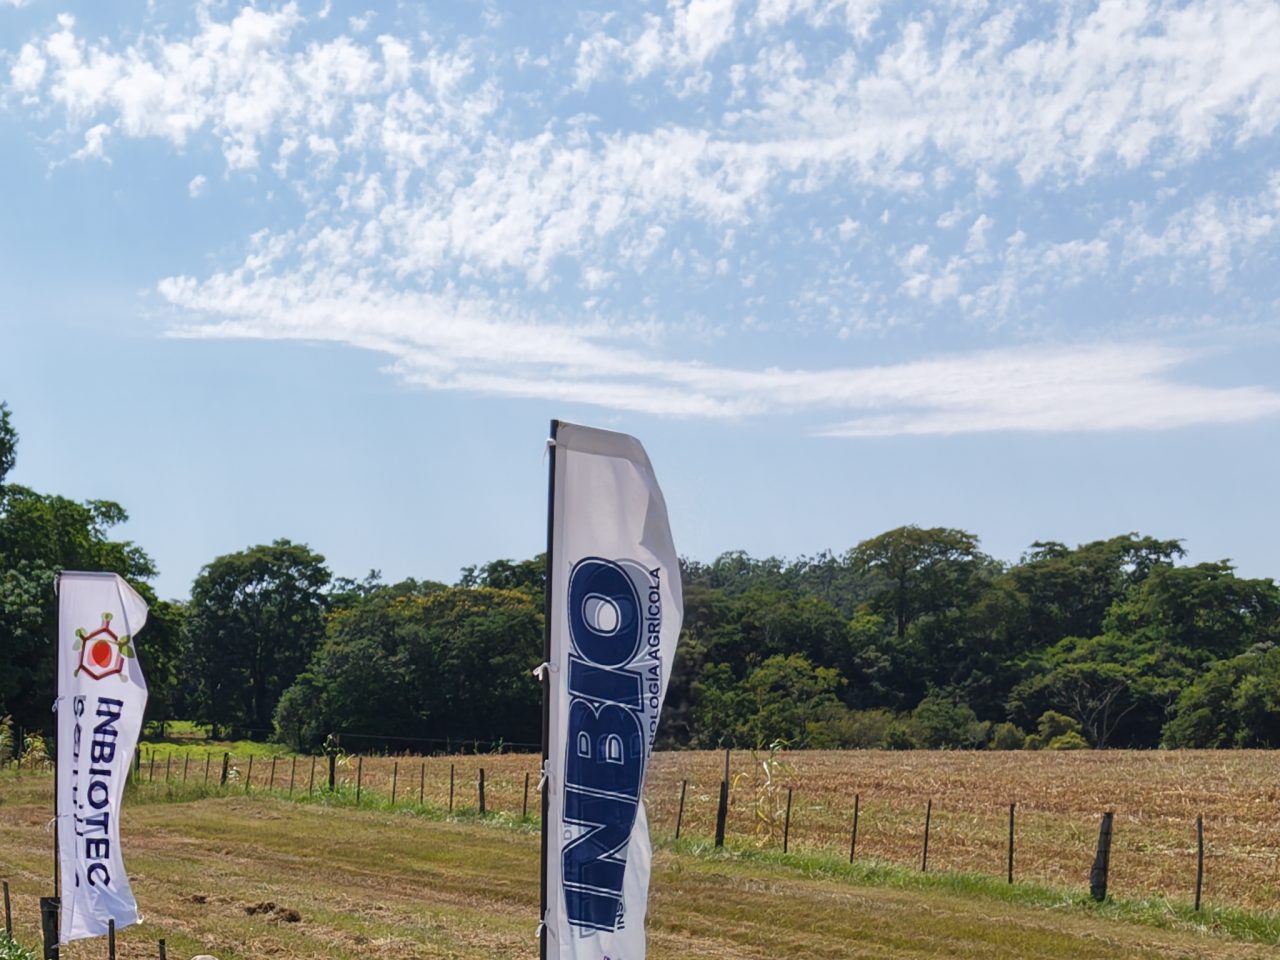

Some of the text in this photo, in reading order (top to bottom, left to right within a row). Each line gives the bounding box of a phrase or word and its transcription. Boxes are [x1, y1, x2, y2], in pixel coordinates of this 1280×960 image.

[645, 567, 661, 661] AGRÍCOLA
[85, 695, 124, 888] INBIOTEC
[561, 556, 646, 935] INBIO
